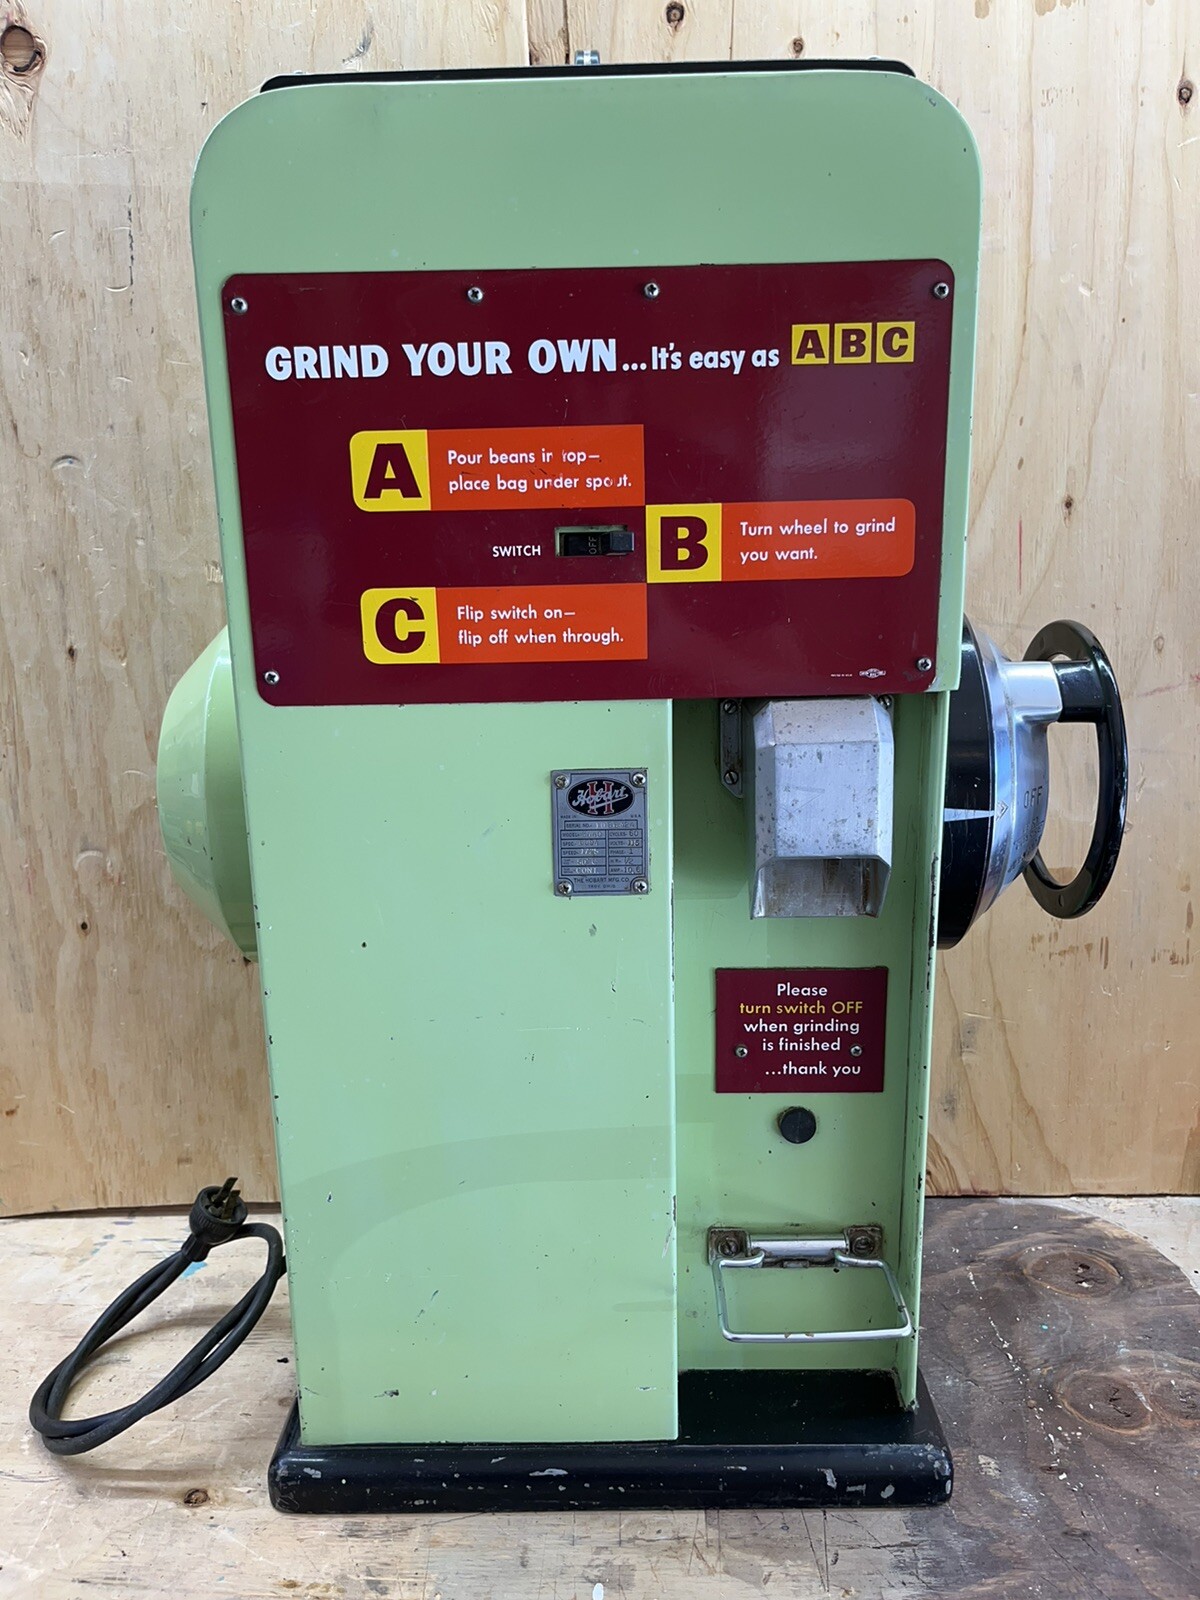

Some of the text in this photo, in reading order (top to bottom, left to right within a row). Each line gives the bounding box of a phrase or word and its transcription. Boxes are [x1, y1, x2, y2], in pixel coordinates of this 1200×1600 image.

[265, 344, 389, 381] GRIND
[402, 341, 513, 377] YOUR
[689, 350, 746, 375] easy
[751, 348, 780, 368] as
[447, 449, 483, 465] Pour
[488, 447, 536, 465] beans
[363, 442, 422, 499] A
[449, 474, 491, 494] place
[496, 473, 528, 493] bag
[534, 473, 580, 490] under
[740, 516, 896, 537] Turn wheel to grind
[492, 544, 541, 558] SWITCH
[588, 536, 598, 555] OFF
[660, 515, 708, 571] B
[740, 546, 818, 565] you want.
[457, 604, 484, 623] Flip
[490, 603, 538, 620] switch
[375, 597, 426, 654] C
[458, 626, 624, 648] flip off when through.
[571, 786, 629, 809] Hobart
[1023, 785, 1043, 810] OFF
[777, 981, 828, 997] Please
[739, 1000, 863, 1014] turn switch OFF
[743, 1017, 860, 1035] when grinding
[762, 1036, 841, 1051] is finished
[832, 1065, 861, 1078] you
